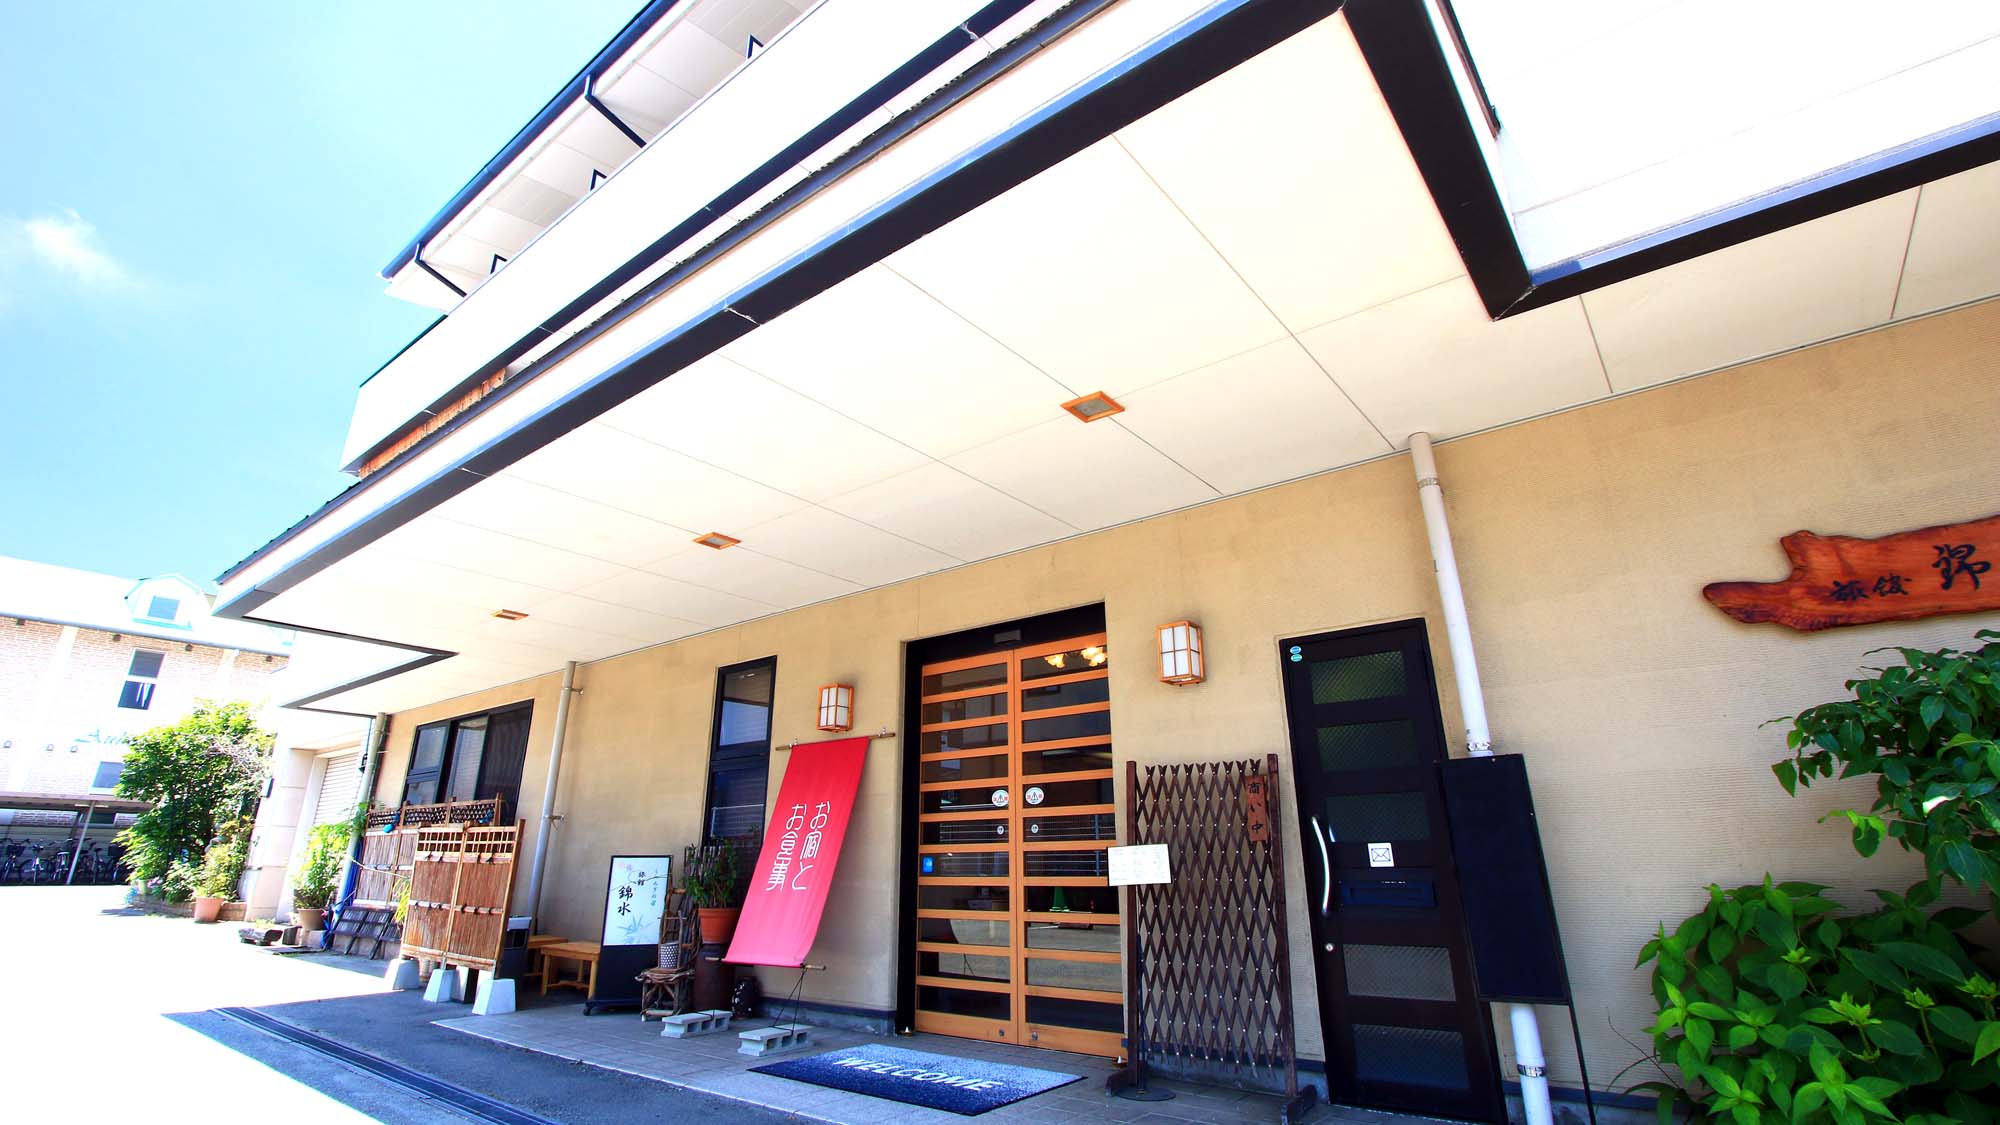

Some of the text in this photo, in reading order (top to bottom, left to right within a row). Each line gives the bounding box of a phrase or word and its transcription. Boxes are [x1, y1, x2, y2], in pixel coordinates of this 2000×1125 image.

[765, 803, 807, 892] お食事
[791, 800, 831, 890] お宿と
[617, 885, 634, 916] 錦水
[832, 1057, 1004, 1092] WELCOME
